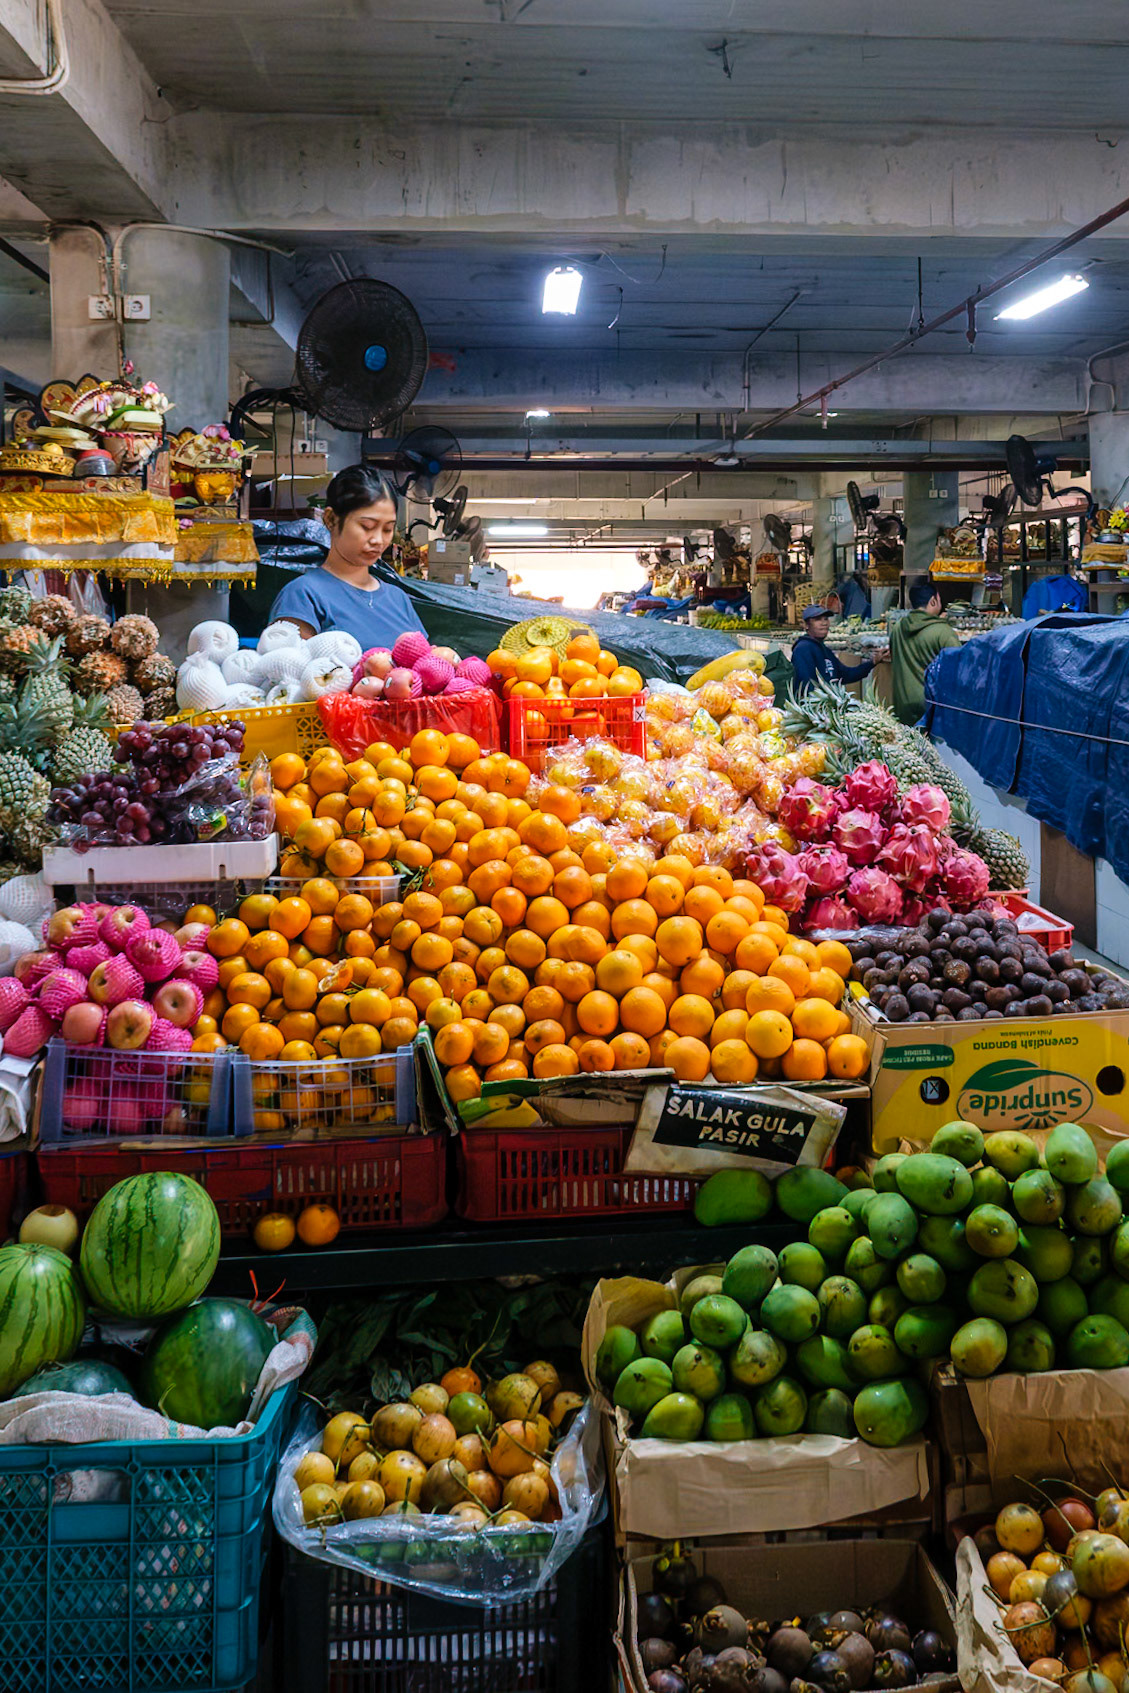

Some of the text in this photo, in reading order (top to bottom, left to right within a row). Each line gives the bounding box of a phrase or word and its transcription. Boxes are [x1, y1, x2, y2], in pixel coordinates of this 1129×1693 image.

[973, 1036, 1079, 1051] Cavendish Banana
[916, 1055, 935, 1063] FROM
[969, 1084, 1083, 1117] Sunpride
[666, 1095, 806, 1138] SALAK GULA
[698, 1125, 761, 1148] PASIR
